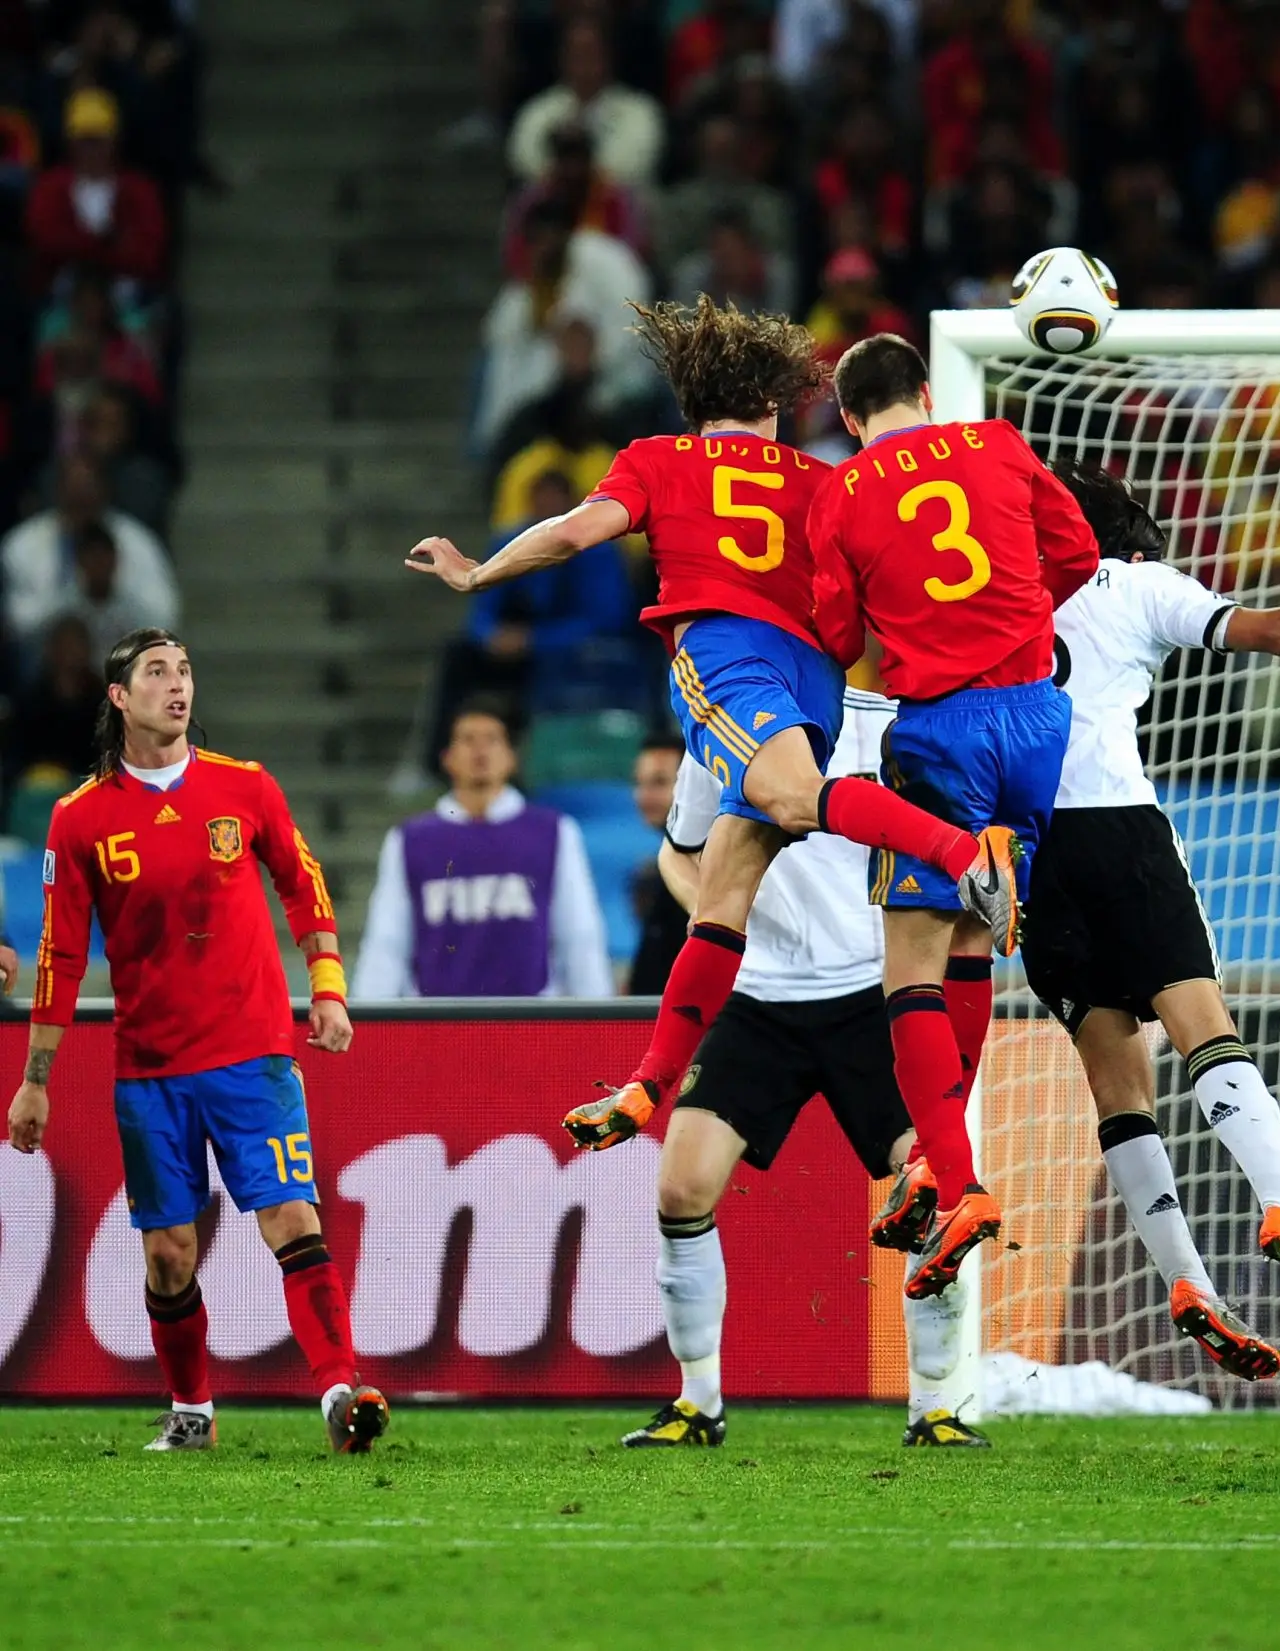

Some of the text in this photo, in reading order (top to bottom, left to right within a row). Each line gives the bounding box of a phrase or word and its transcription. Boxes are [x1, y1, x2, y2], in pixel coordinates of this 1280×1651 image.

[844, 425, 984, 496] PIQUÉ
[713, 465, 785, 573] 5
[897, 480, 991, 602] 3
[95, 831, 140, 884] 15
[422, 873, 537, 926] FIFA
[266, 1132, 314, 1184] 15
